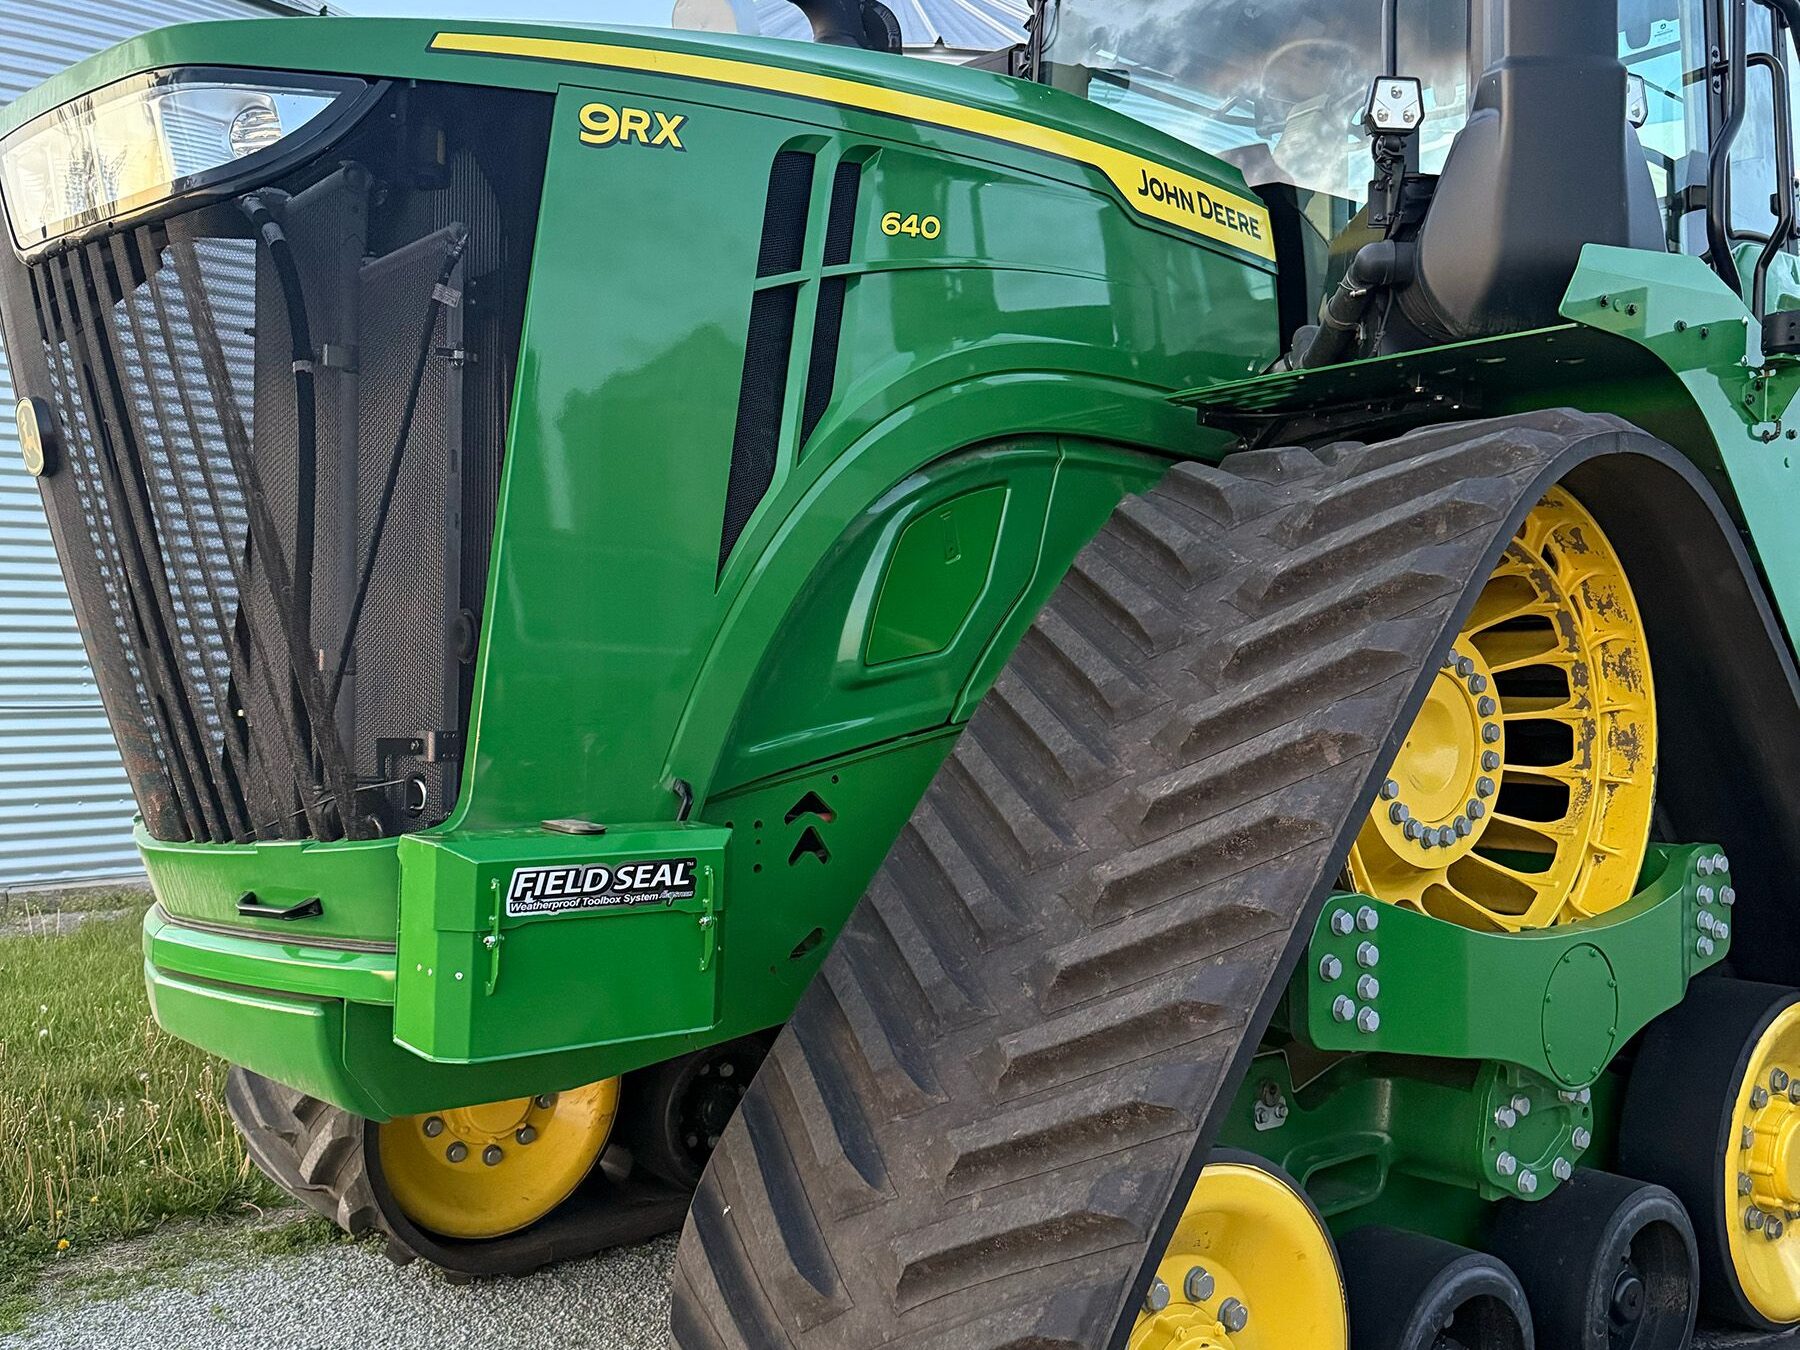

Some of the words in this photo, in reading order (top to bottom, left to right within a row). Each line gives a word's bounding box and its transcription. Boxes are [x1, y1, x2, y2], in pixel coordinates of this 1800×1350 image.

[579, 102, 687, 151] 9RX
[1137, 168, 1196, 214] JOHN
[1196, 190, 1262, 240] DEERE
[880, 210, 942, 240] 640
[513, 868, 609, 898] FIELD
[510, 897, 580, 912] Weatherproof
[581, 895, 622, 907] Toolbox
[623, 892, 659, 906] System
